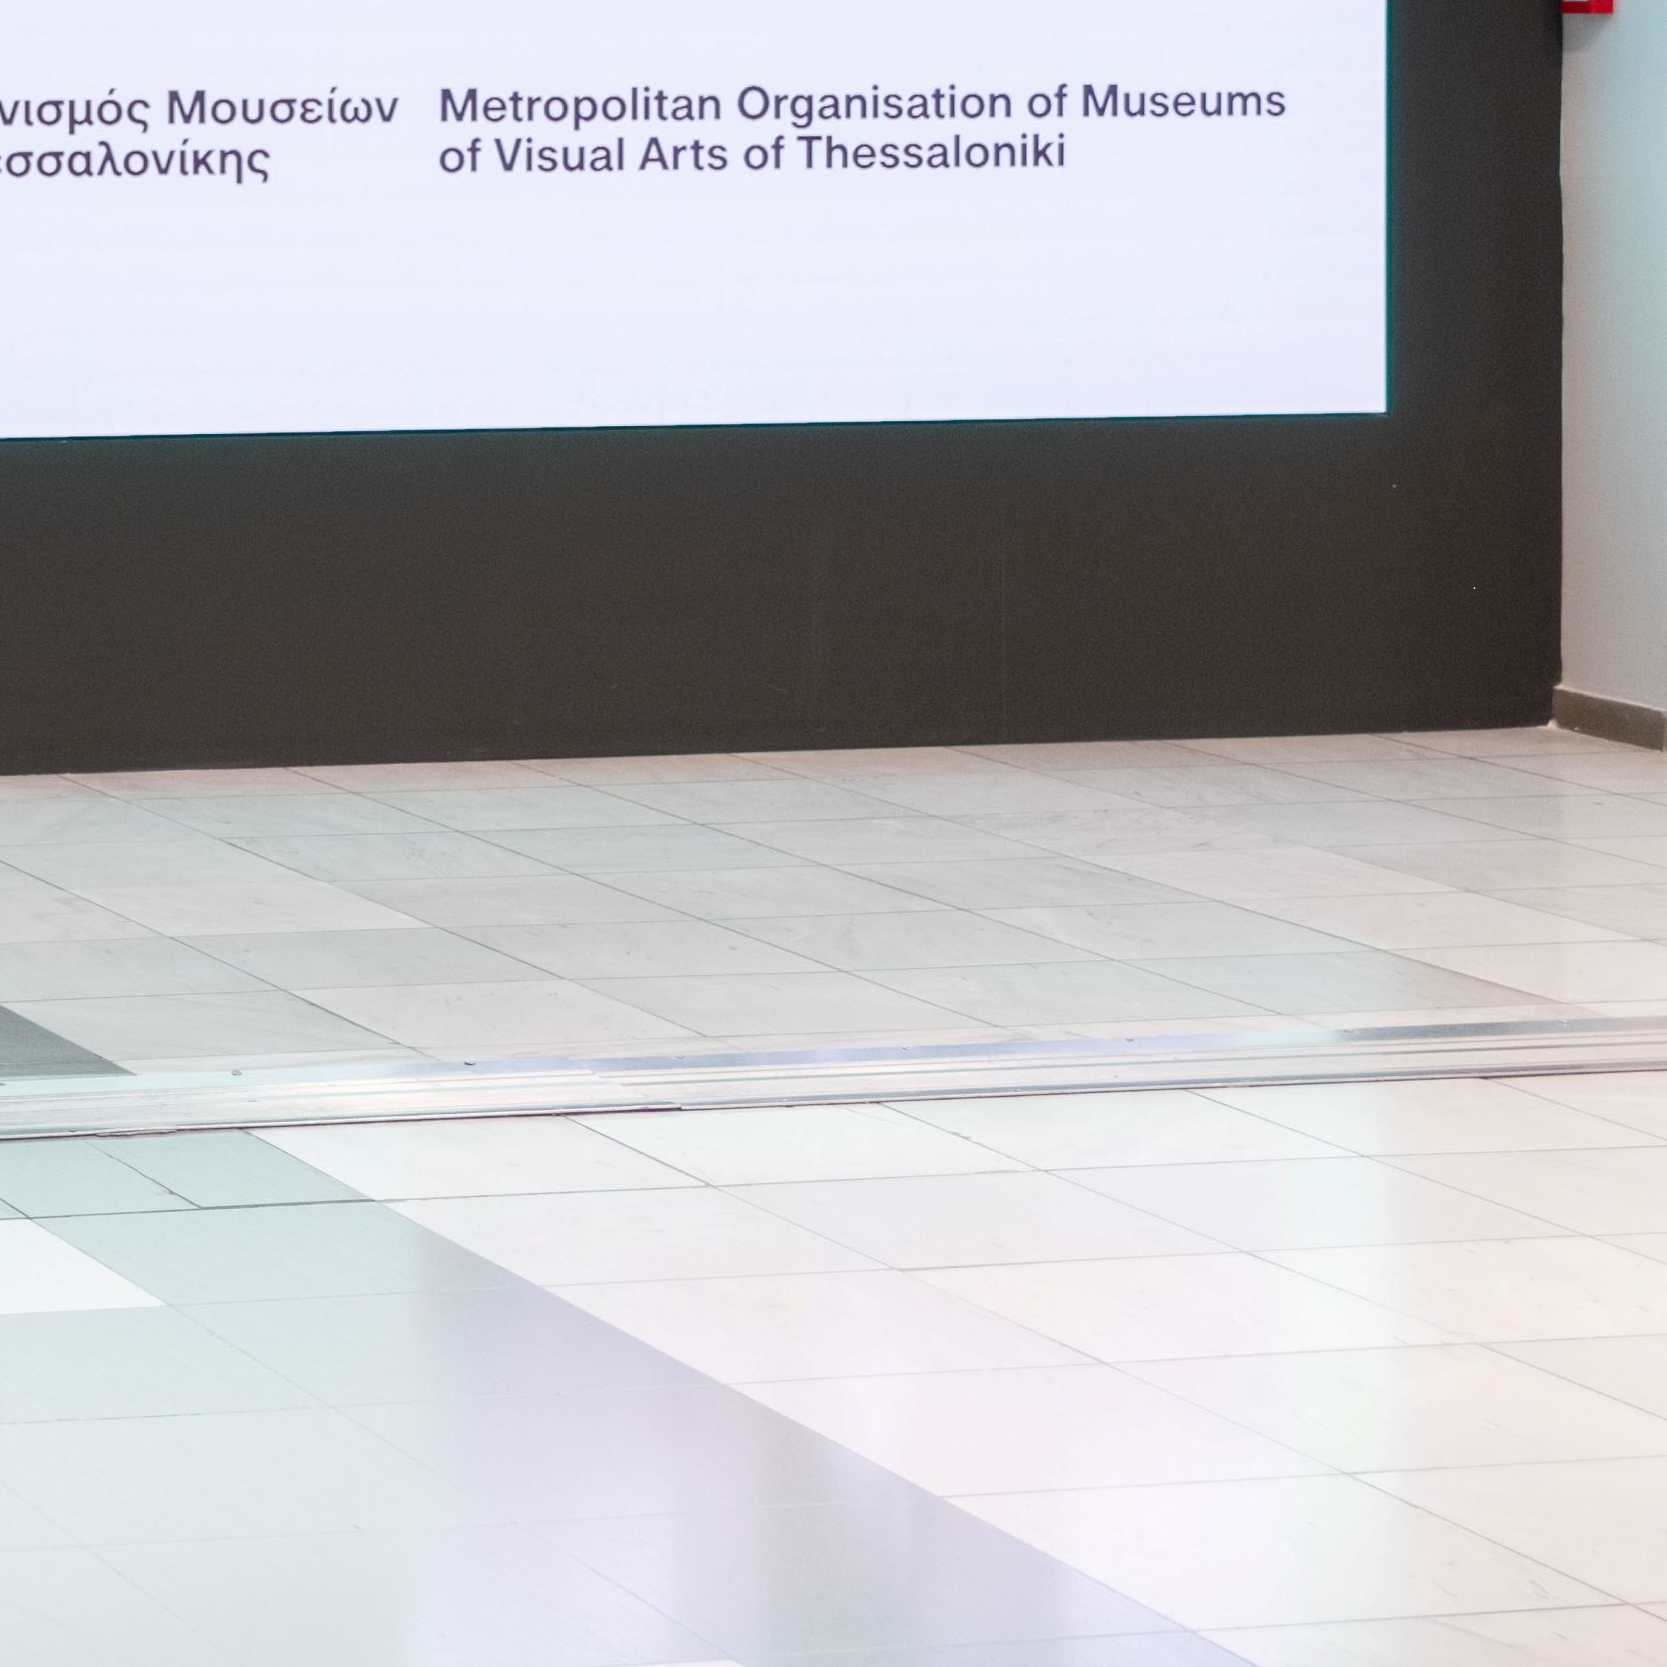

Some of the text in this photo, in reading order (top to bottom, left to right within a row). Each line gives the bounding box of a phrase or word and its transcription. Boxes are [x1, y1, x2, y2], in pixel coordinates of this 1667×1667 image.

[165, 86, 399, 126] Μουσείων
[439, 83, 1288, 131] Metropolitan Organisation of Museums
[438, 133, 1067, 174] of Visual Arts of Thessaloniki
